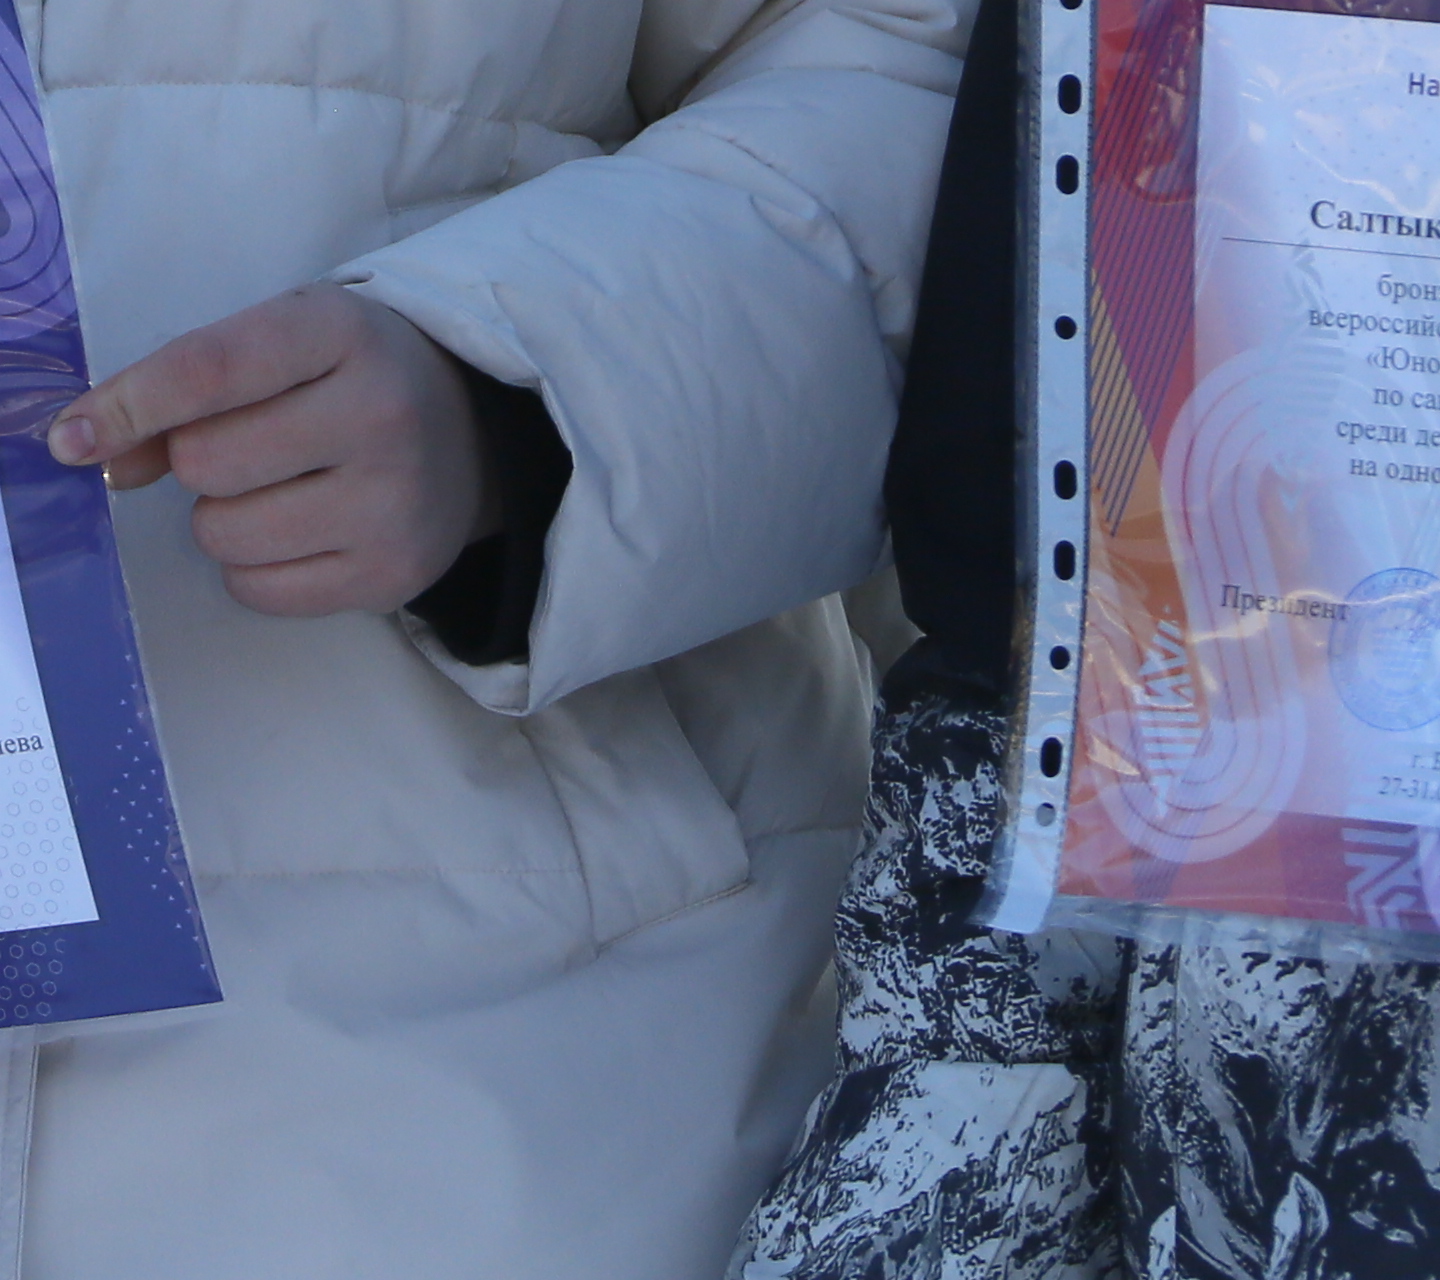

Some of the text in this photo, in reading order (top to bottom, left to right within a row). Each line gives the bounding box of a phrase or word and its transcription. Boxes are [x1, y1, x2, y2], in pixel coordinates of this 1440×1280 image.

[1373, 387, 1404, 407] по
[1336, 421, 1406, 444] среди
[1349, 458, 1377, 476] на
